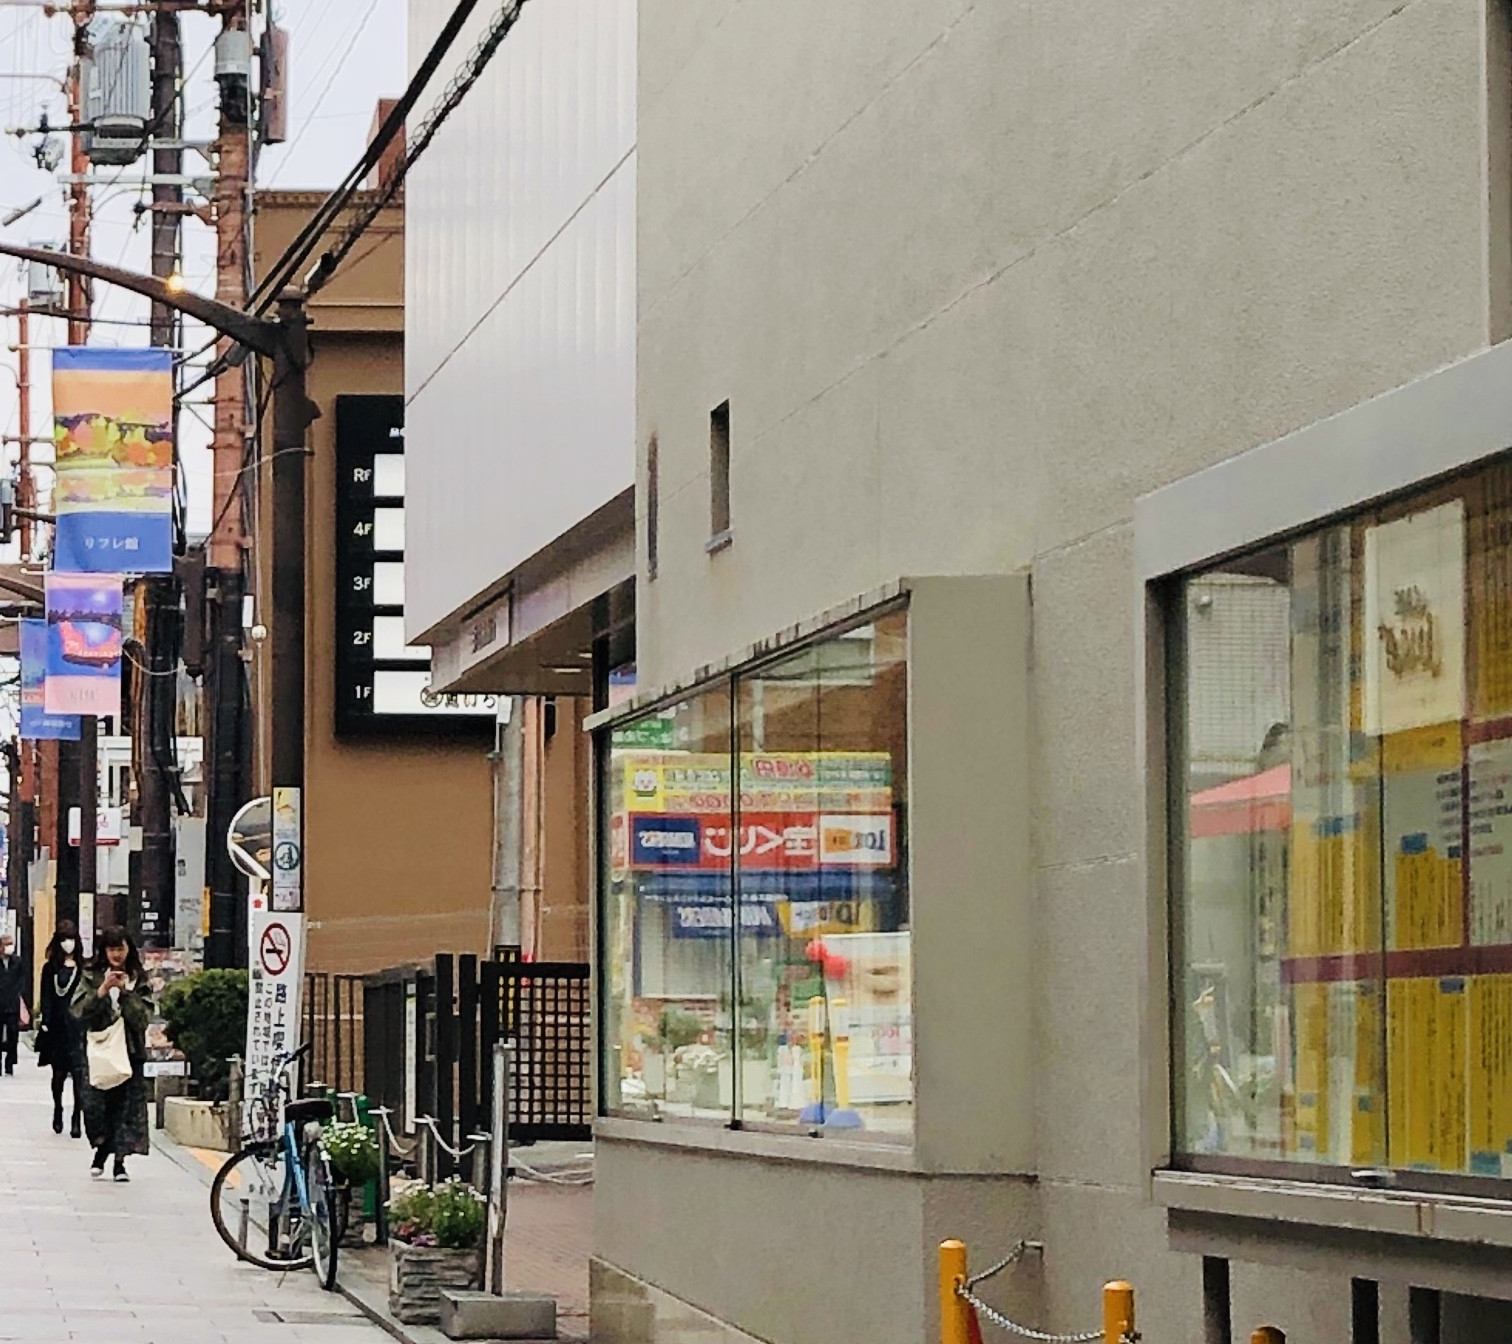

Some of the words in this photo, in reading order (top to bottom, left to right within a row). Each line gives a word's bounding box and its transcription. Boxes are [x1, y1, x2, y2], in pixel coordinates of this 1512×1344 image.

[353, 468, 372, 482] RF
[353, 522, 372, 536] 4F
[353, 576, 372, 591] 3F
[353, 631, 372, 646] 2F
[353, 685, 372, 699] 1F
